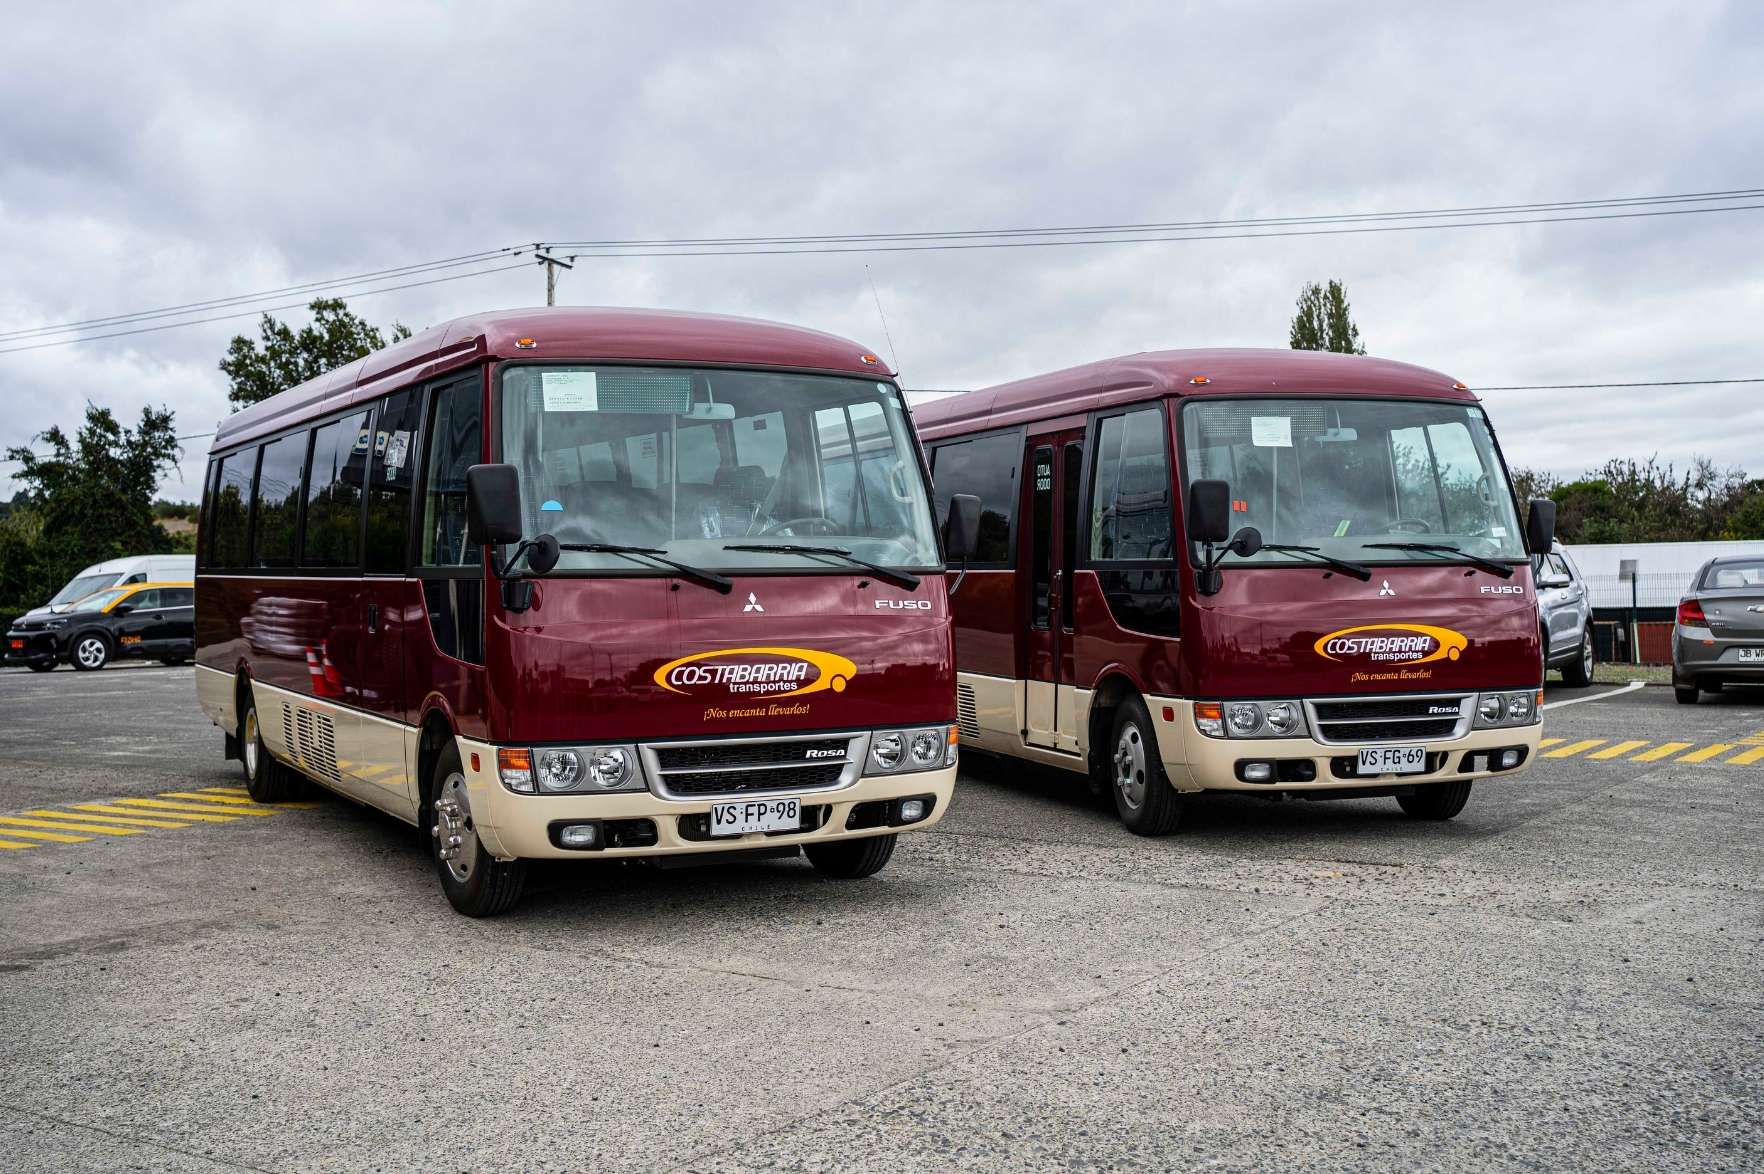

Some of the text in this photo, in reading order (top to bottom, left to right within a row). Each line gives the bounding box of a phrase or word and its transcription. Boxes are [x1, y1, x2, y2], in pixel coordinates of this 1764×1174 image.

[1480, 586, 1524, 594] FUSO
[874, 599, 932, 610] FUSO
[1327, 636, 1430, 654] COSTABARRIA
[1371, 651, 1423, 662] transportes
[671, 662, 808, 685] COSTABARRIA
[1351, 669, 1432, 683] ¡Nos encanta llevarlos!
[729, 681, 798, 693] transportes
[703, 702, 810, 721] ¡Nos encanta llevarlos!
